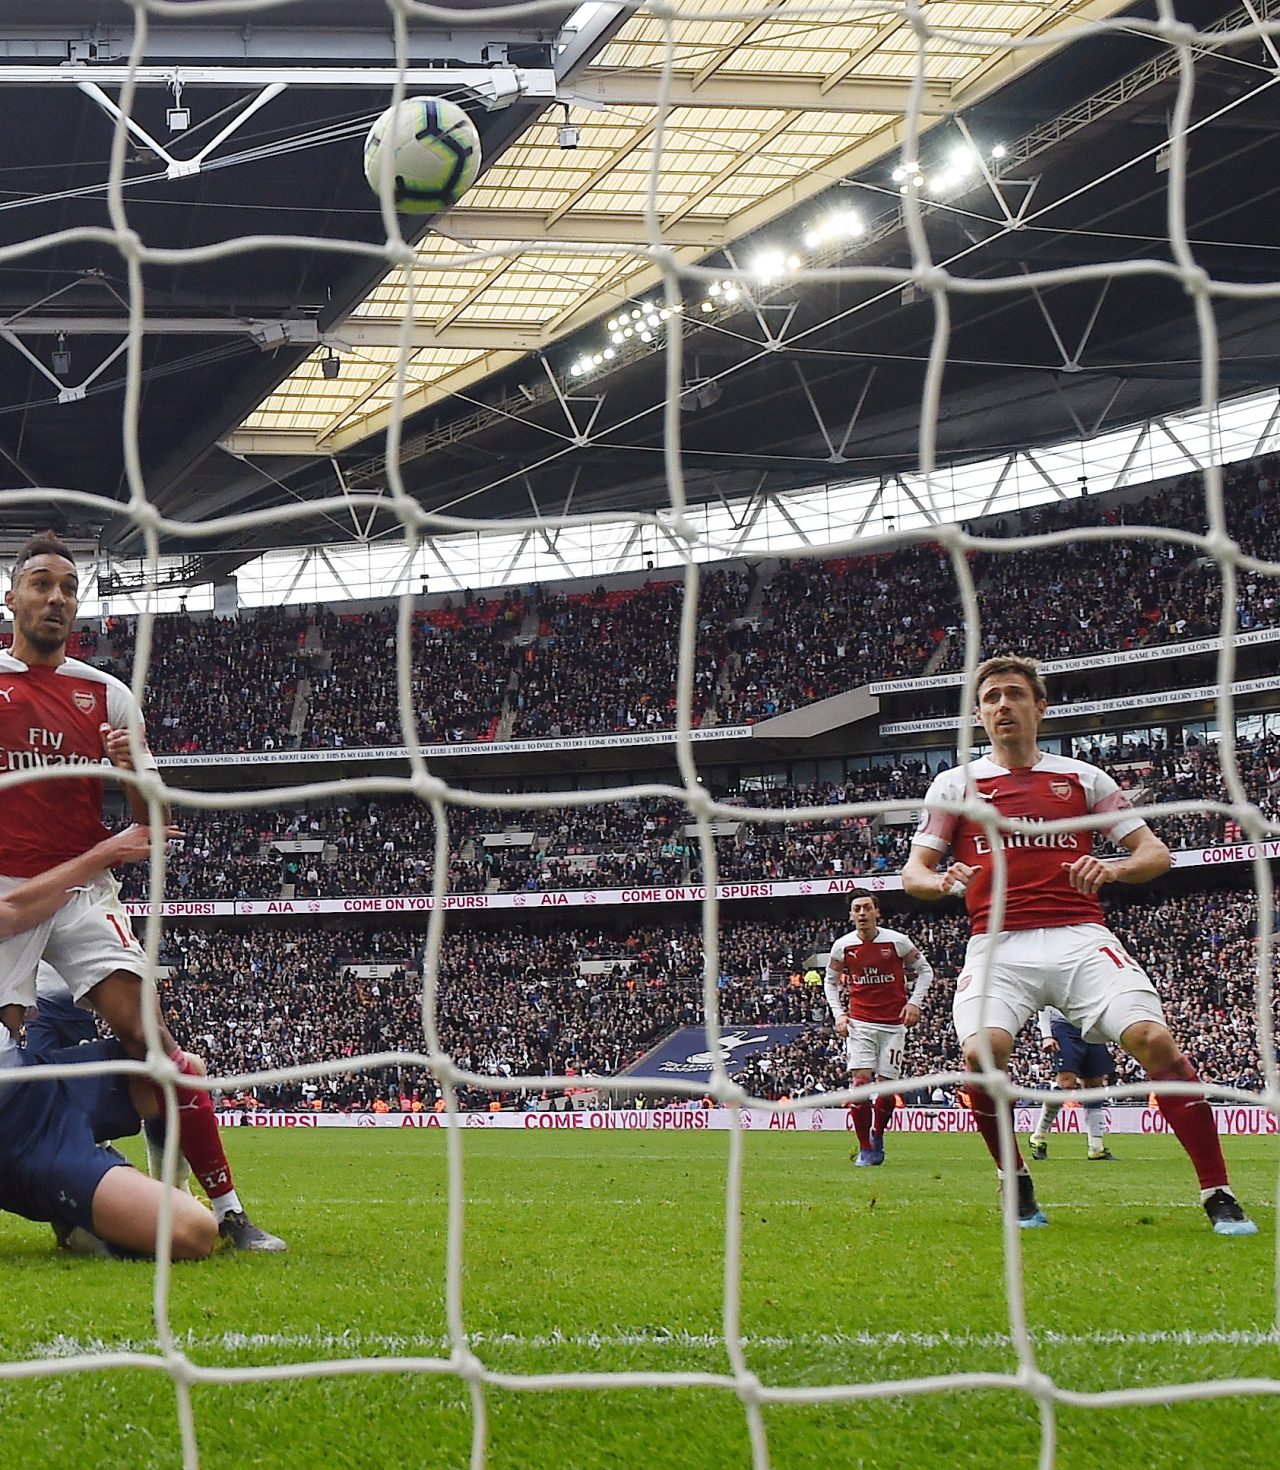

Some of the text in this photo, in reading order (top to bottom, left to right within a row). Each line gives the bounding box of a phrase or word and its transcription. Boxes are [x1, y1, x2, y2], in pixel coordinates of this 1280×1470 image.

[1082, 659, 1105, 667] SPURS
[1113, 655, 1127, 663] THE
[1129, 652, 1149, 661] GAME
[1161, 647, 1185, 656] ABOUT
[1188, 642, 1210, 652] GLORY
[871, 678, 948, 692] TOTTENHAM HOTSPUR
[1072, 704, 1094, 713] SPURS
[1116, 699, 1135, 707] GAME
[1146, 695, 1168, 703] ABOUT
[1170, 693, 1192, 701] GLORY
[882, 721, 953, 733] TOTTENHAM HOTSPUR
[28, 727, 64, 753] Fly
[1203, 847, 1243, 863] COME
[621, 889, 660, 902] COME
[665, 888, 685, 900] ON
[721, 884, 773, 897] SPURS!
[828, 879, 857, 891] AIA
[267, 901, 294, 913] AIA
[344, 900, 382, 911] COME
[385, 899, 405, 910] ON
[441, 896, 489, 908] SPURS!
[541, 893, 569, 905] AIA
[168, 904, 216, 915] SPURS!
[106, 913, 137, 948] 1
[851, 974, 896, 985] Emirates
[889, 1049, 902, 1066] 10
[401, 1115, 441, 1127] AIA
[524, 1111, 709, 1129] COME ON YOU SPURS!
[770, 1111, 797, 1129] AIA
[907, 1111, 933, 1131] YOU
[1224, 1109, 1260, 1134] YOU
[206, 1171, 228, 1189] 14
